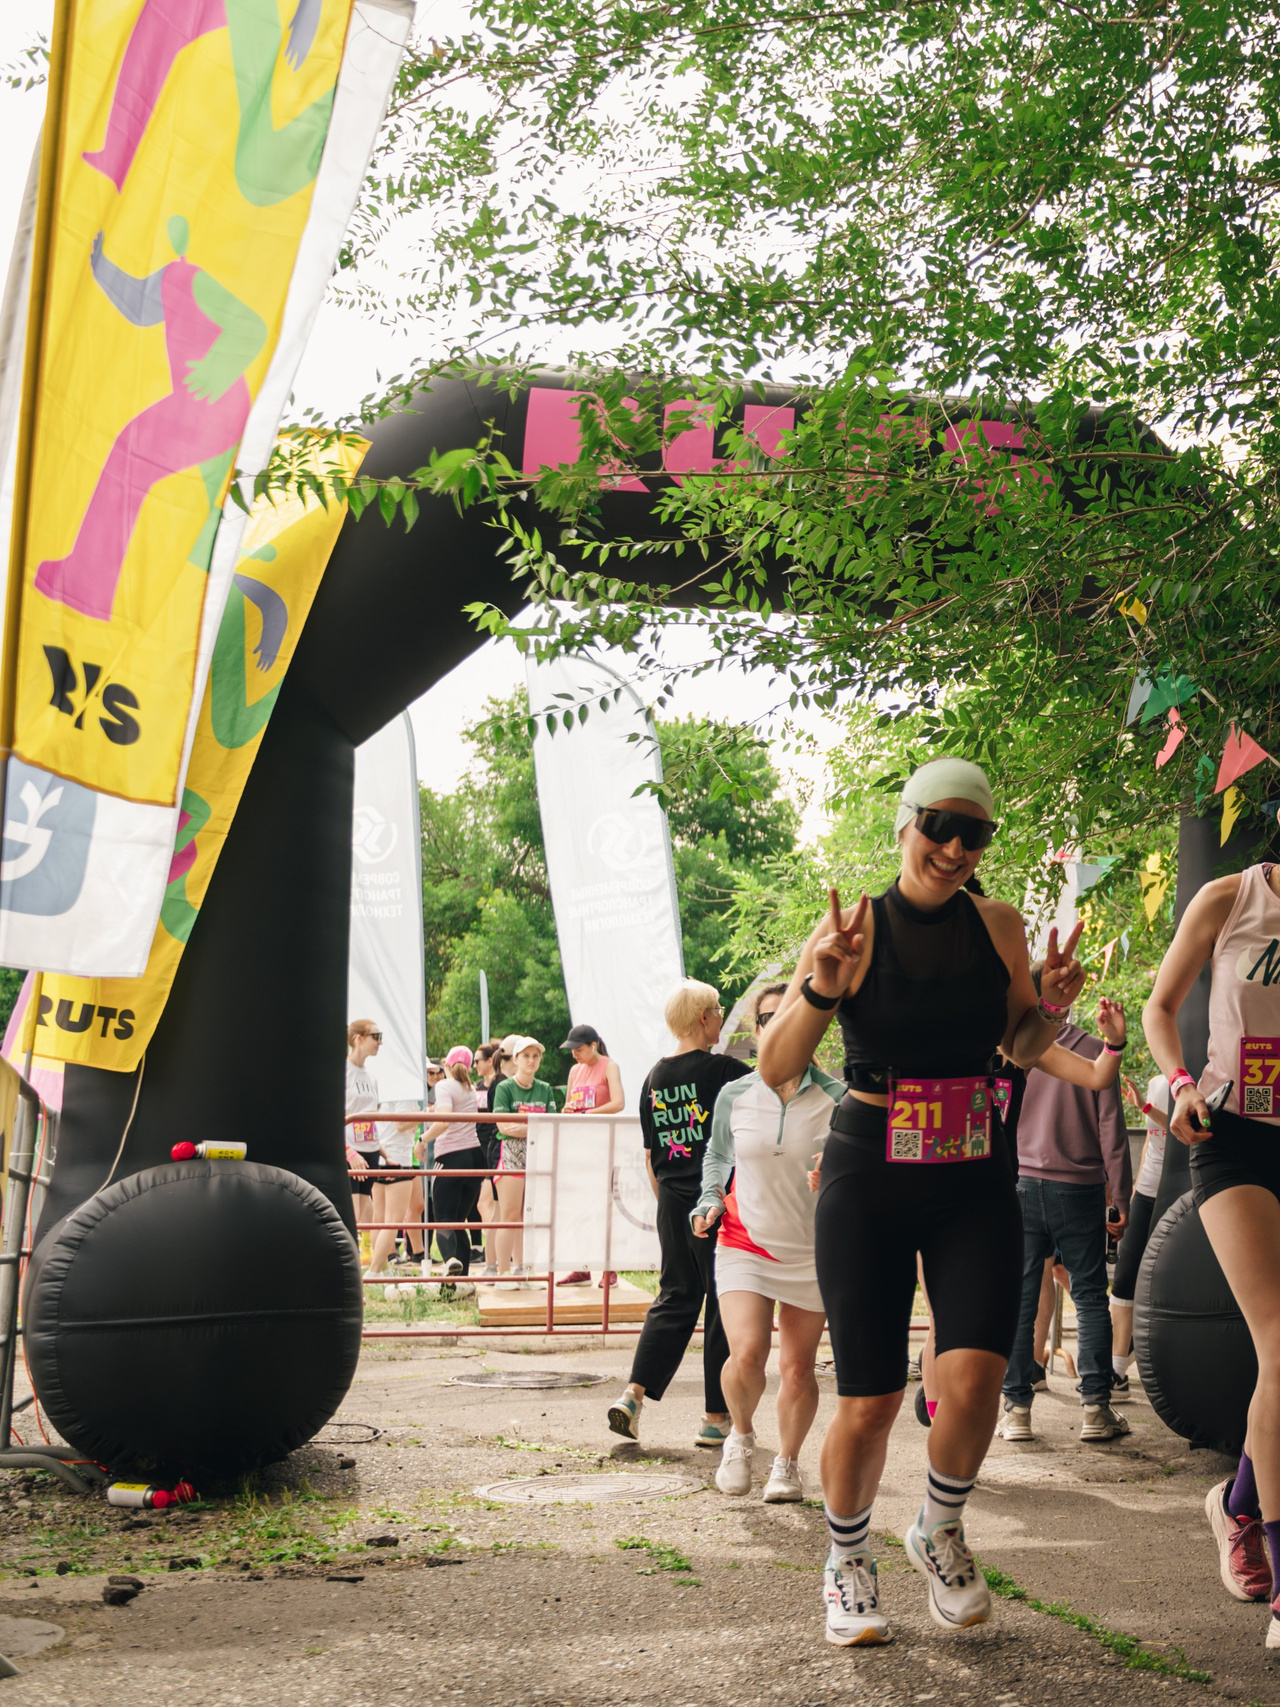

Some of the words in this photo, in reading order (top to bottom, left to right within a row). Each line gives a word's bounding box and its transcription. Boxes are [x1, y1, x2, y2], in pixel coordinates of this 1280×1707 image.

[652, 1083, 697, 1105] RUN
[975, 1093, 983, 1104] 2
[653, 1105, 700, 1127] RUN
[890, 1100, 942, 1129] 211
[354, 1122, 371, 1132] 257
[658, 1125, 704, 1148] RUN
